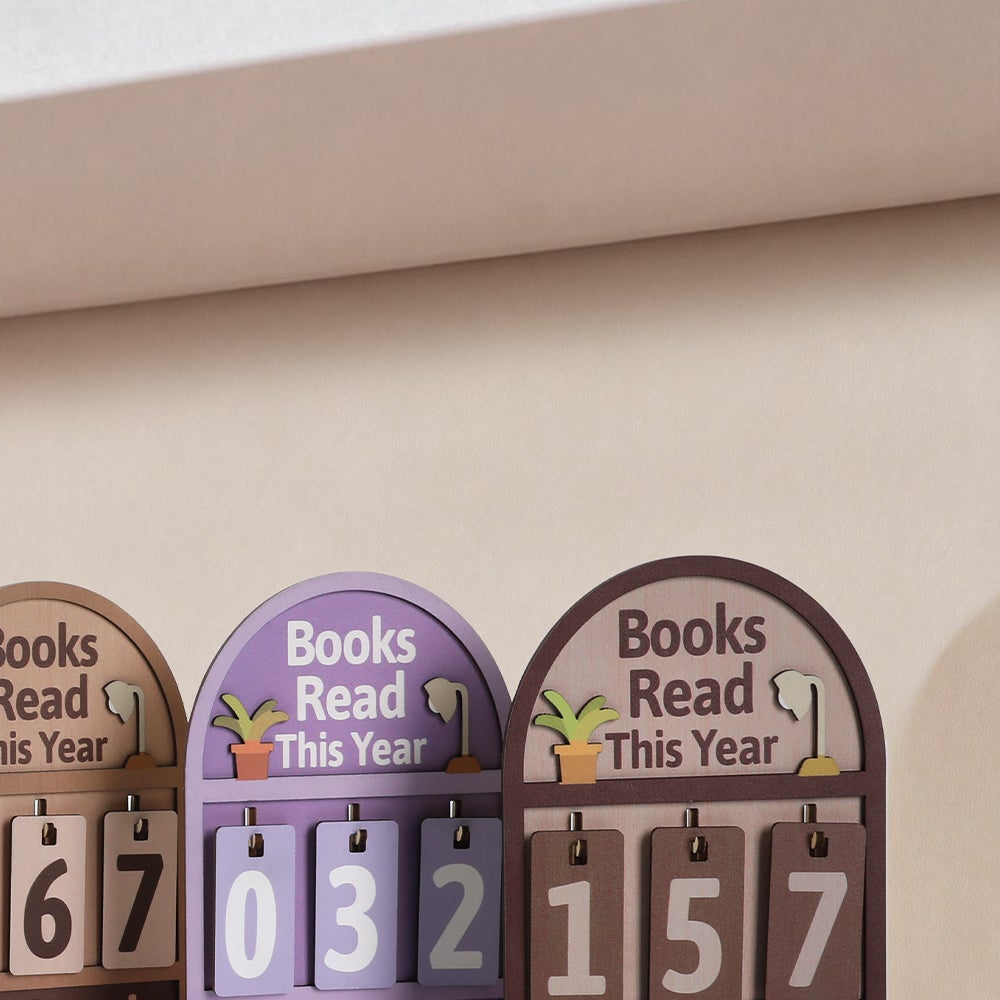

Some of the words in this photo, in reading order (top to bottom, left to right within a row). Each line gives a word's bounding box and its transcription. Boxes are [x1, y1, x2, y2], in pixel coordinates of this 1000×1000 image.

[287, 615, 416, 666] Books
[618, 602, 767, 659] Books
[297, 670, 405, 721] Read
[629, 661, 753, 718] Read
[39, 731, 108, 763] Year
[275, 731, 343, 768] This
[350, 731, 427, 766] Year
[605, 729, 683, 770] This
[691, 729, 778, 766] Year
